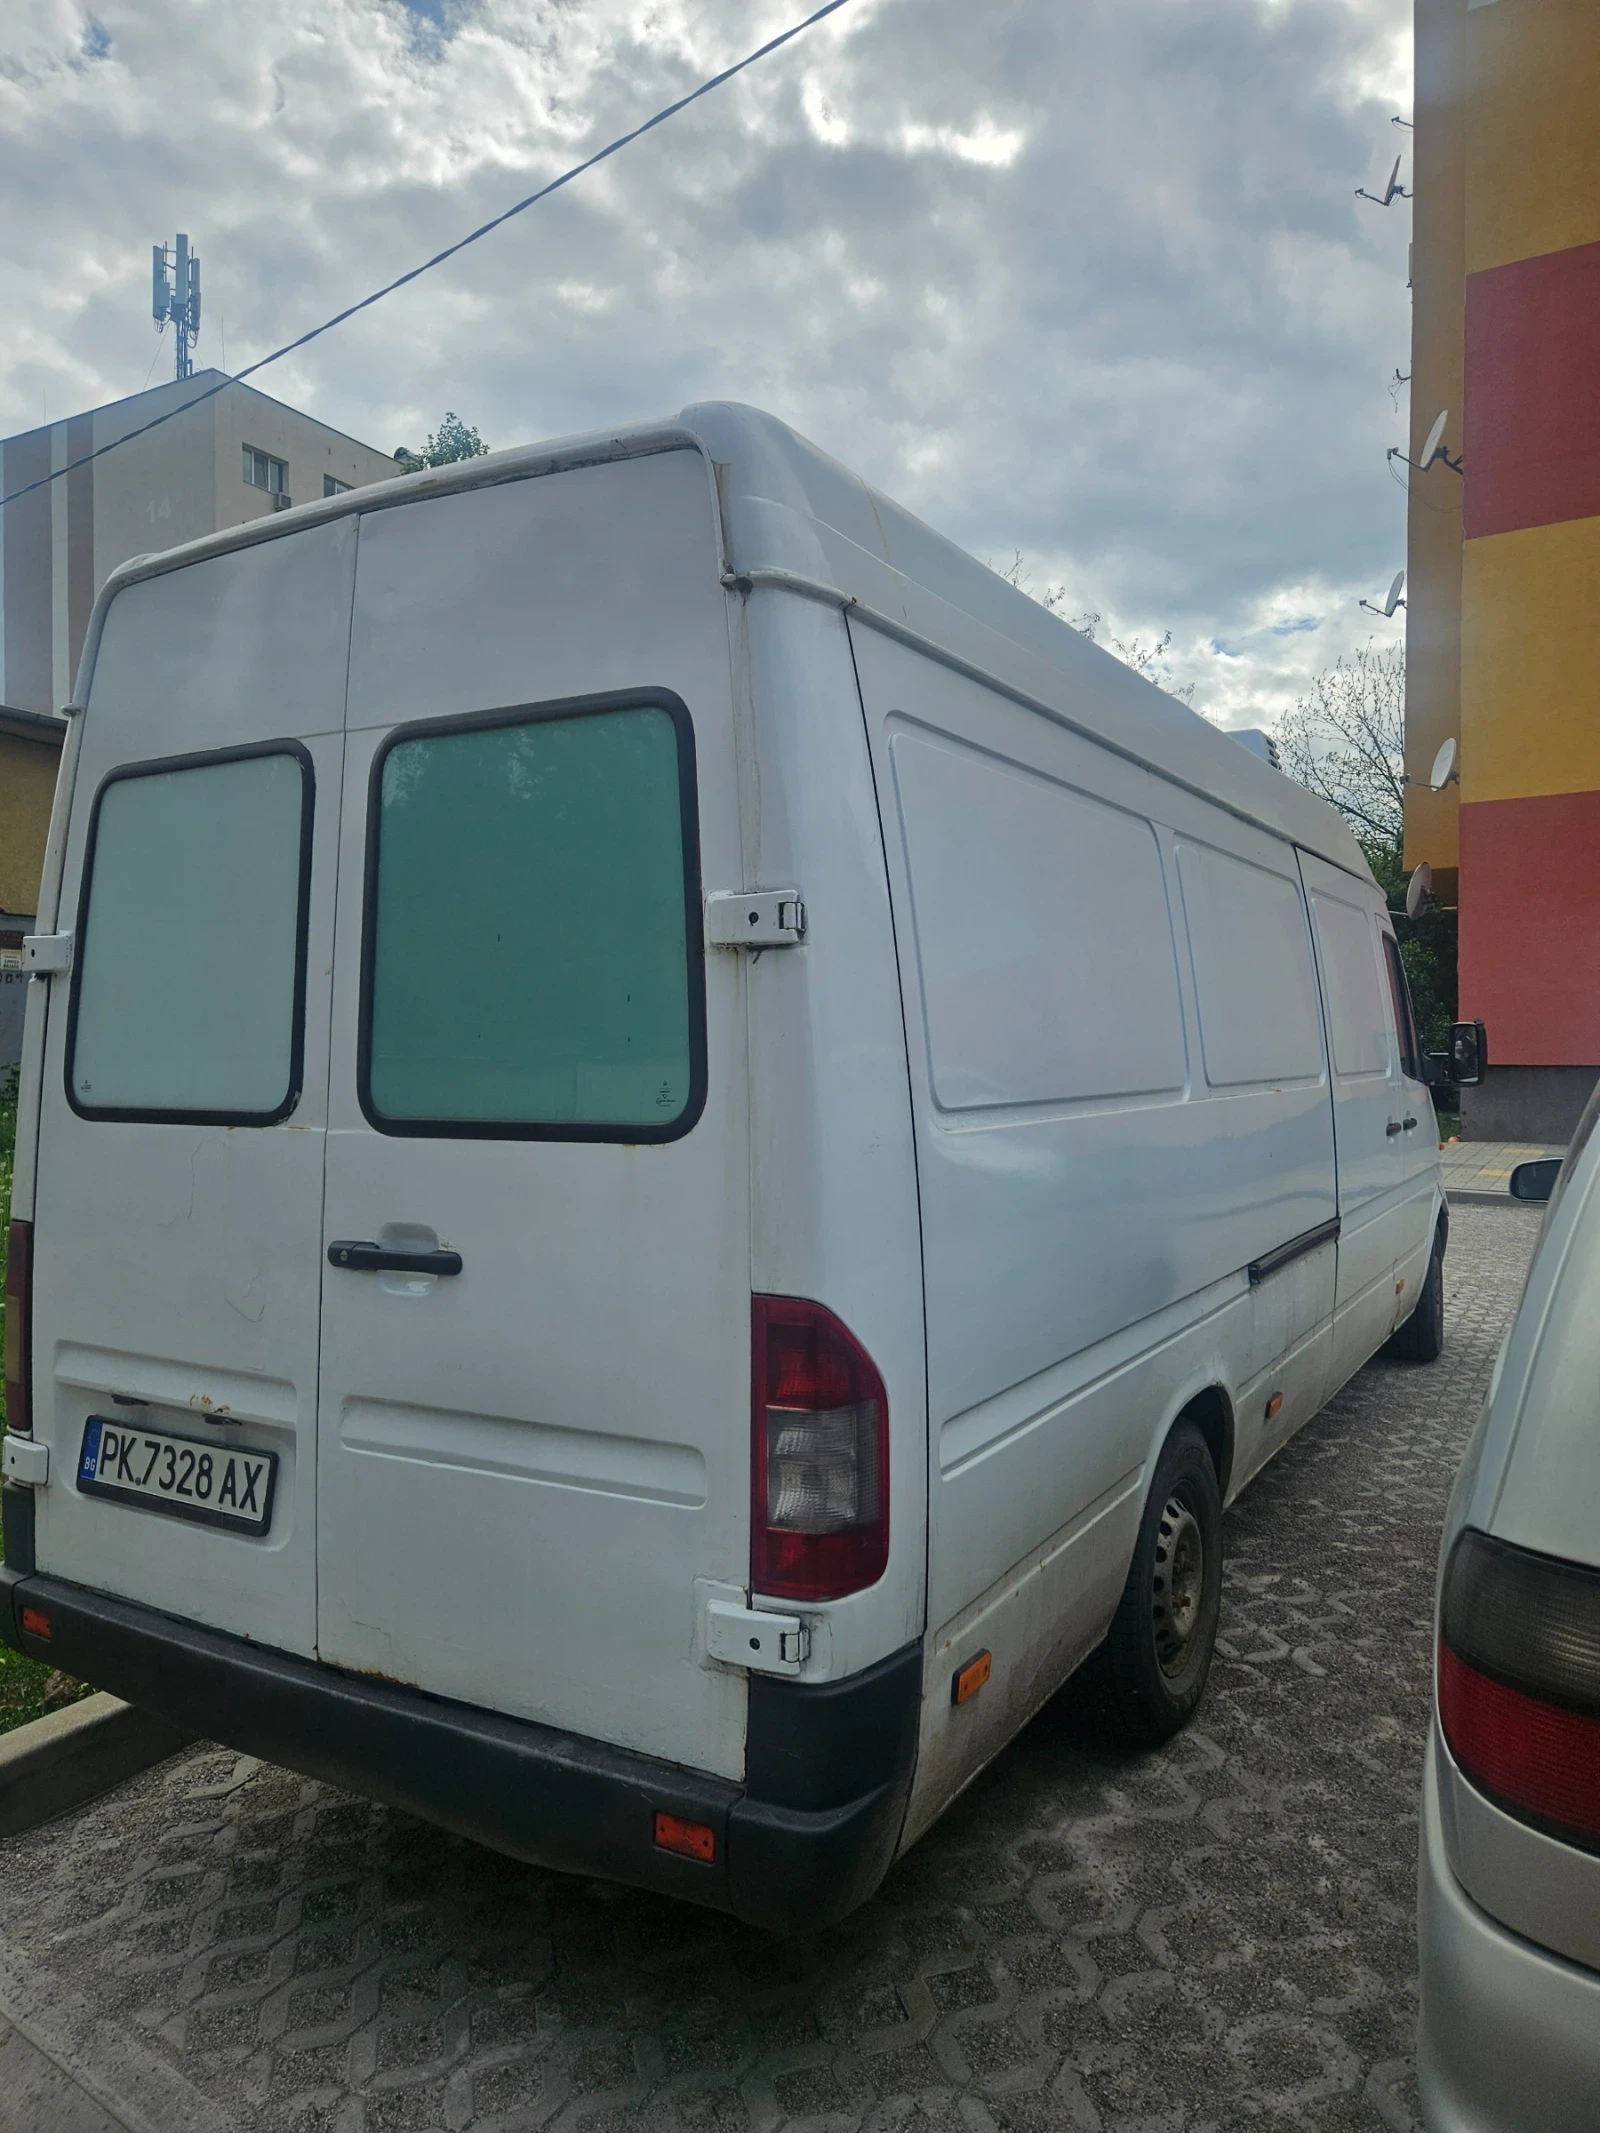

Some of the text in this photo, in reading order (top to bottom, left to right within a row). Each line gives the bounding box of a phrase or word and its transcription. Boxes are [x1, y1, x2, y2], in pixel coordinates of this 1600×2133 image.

[146, 496, 172, 523] 14
[84, 1456, 96, 1471] BG
[218, 1458, 264, 1513] AX
